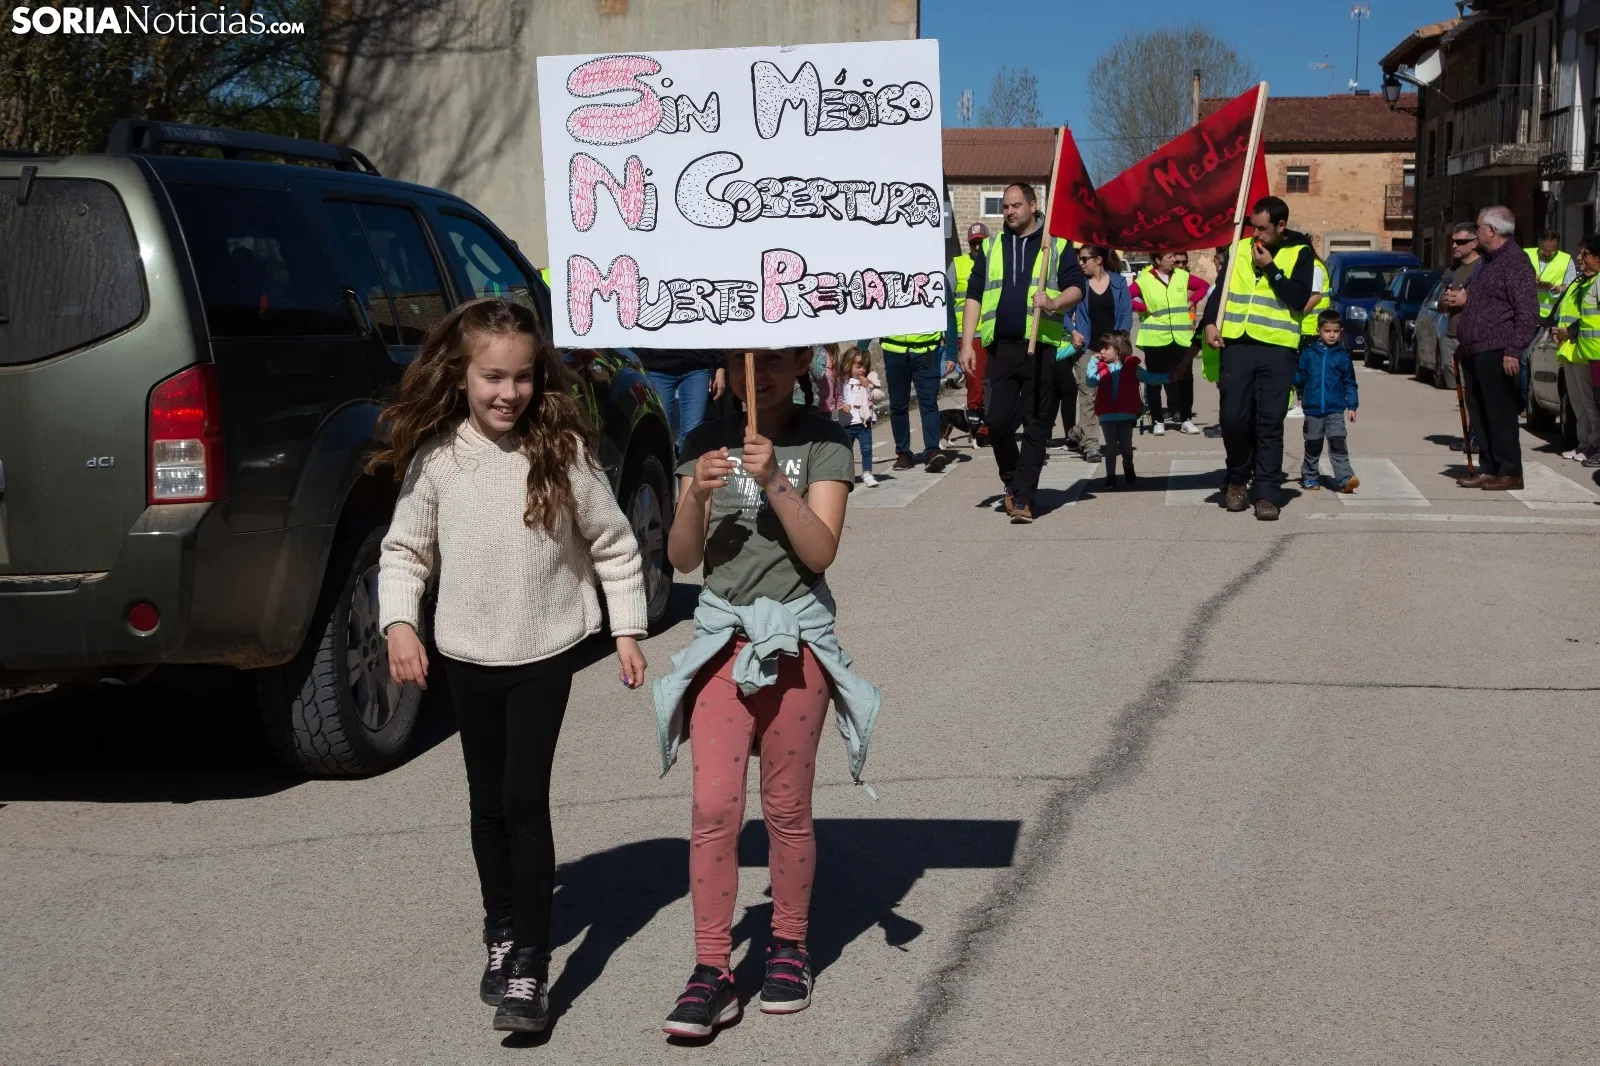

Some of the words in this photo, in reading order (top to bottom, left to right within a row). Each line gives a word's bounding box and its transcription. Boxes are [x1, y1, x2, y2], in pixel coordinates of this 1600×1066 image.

[568, 151, 659, 232] Ni
[1153, 131, 1249, 197] Medic
[86, 456, 114, 467] dCi
